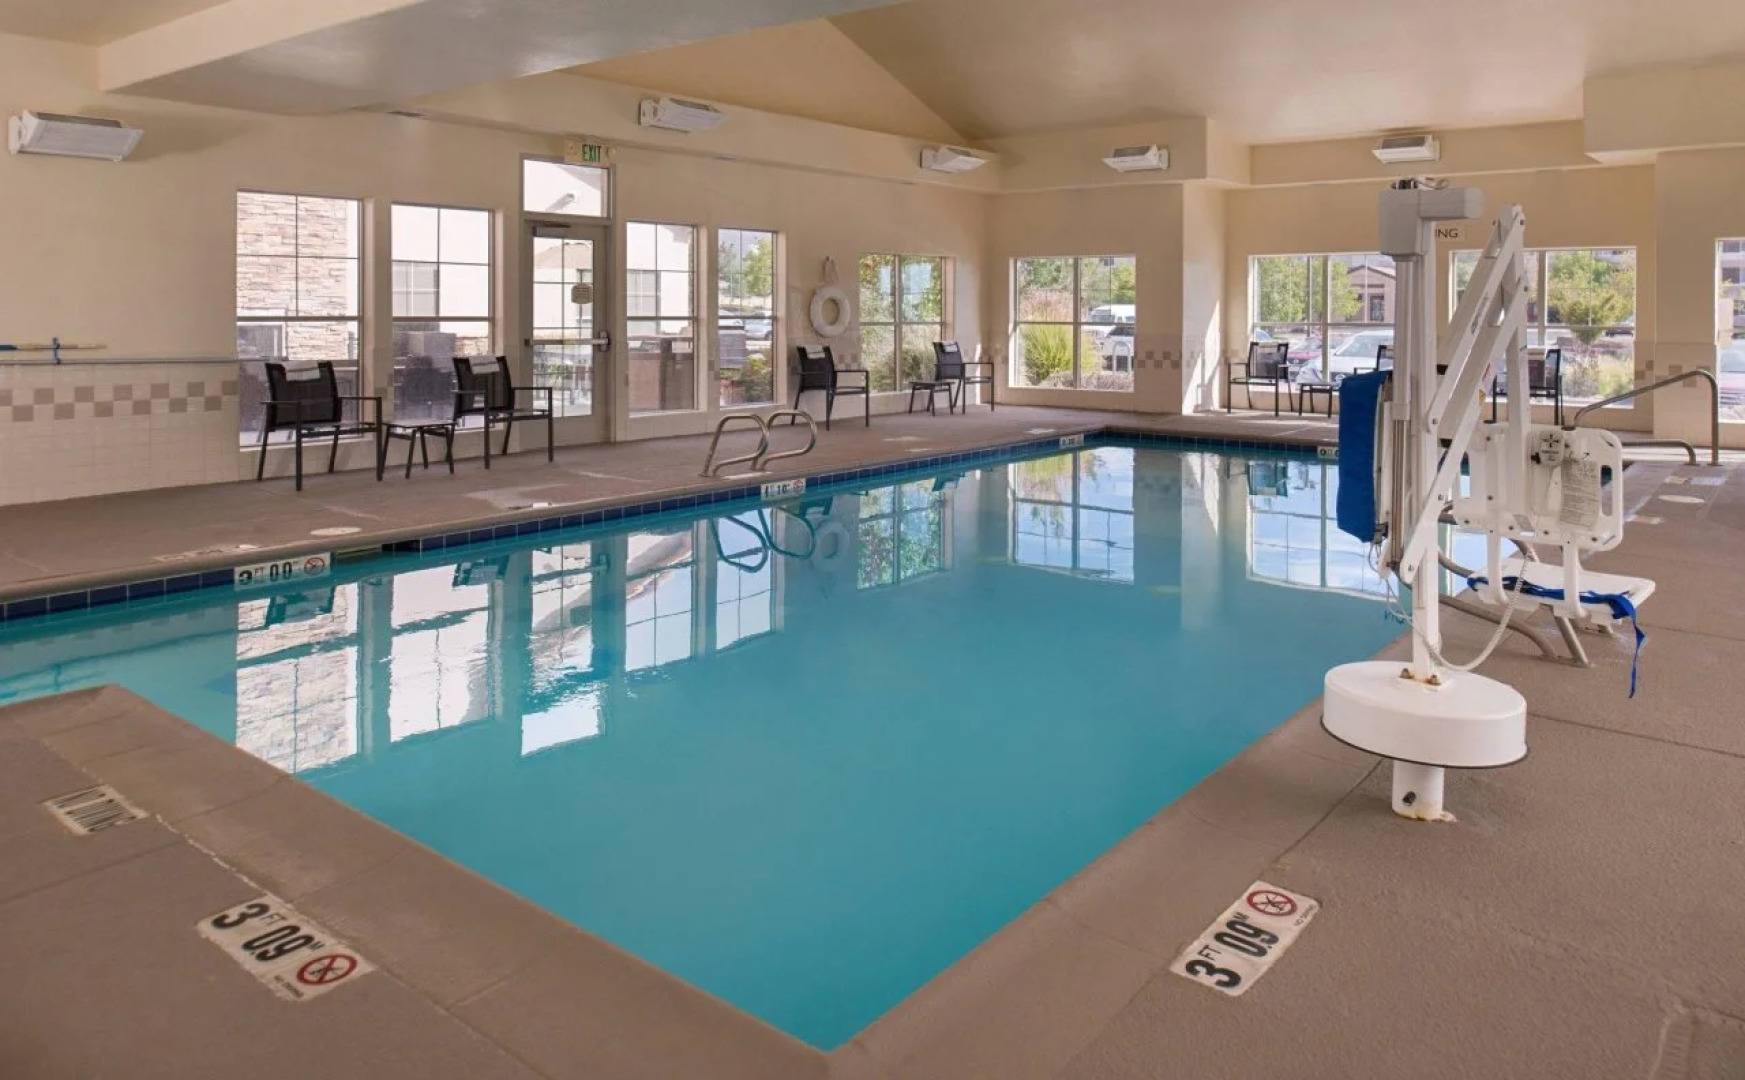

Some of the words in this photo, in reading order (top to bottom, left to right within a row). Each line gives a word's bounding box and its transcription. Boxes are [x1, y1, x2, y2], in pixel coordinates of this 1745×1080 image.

[581, 143, 602, 163] EXIT
[211, 903, 270, 930] 3
[258, 912, 287, 926] FT
[1197, 944, 1222, 961] FT
[1185, 959, 1242, 988] 3
